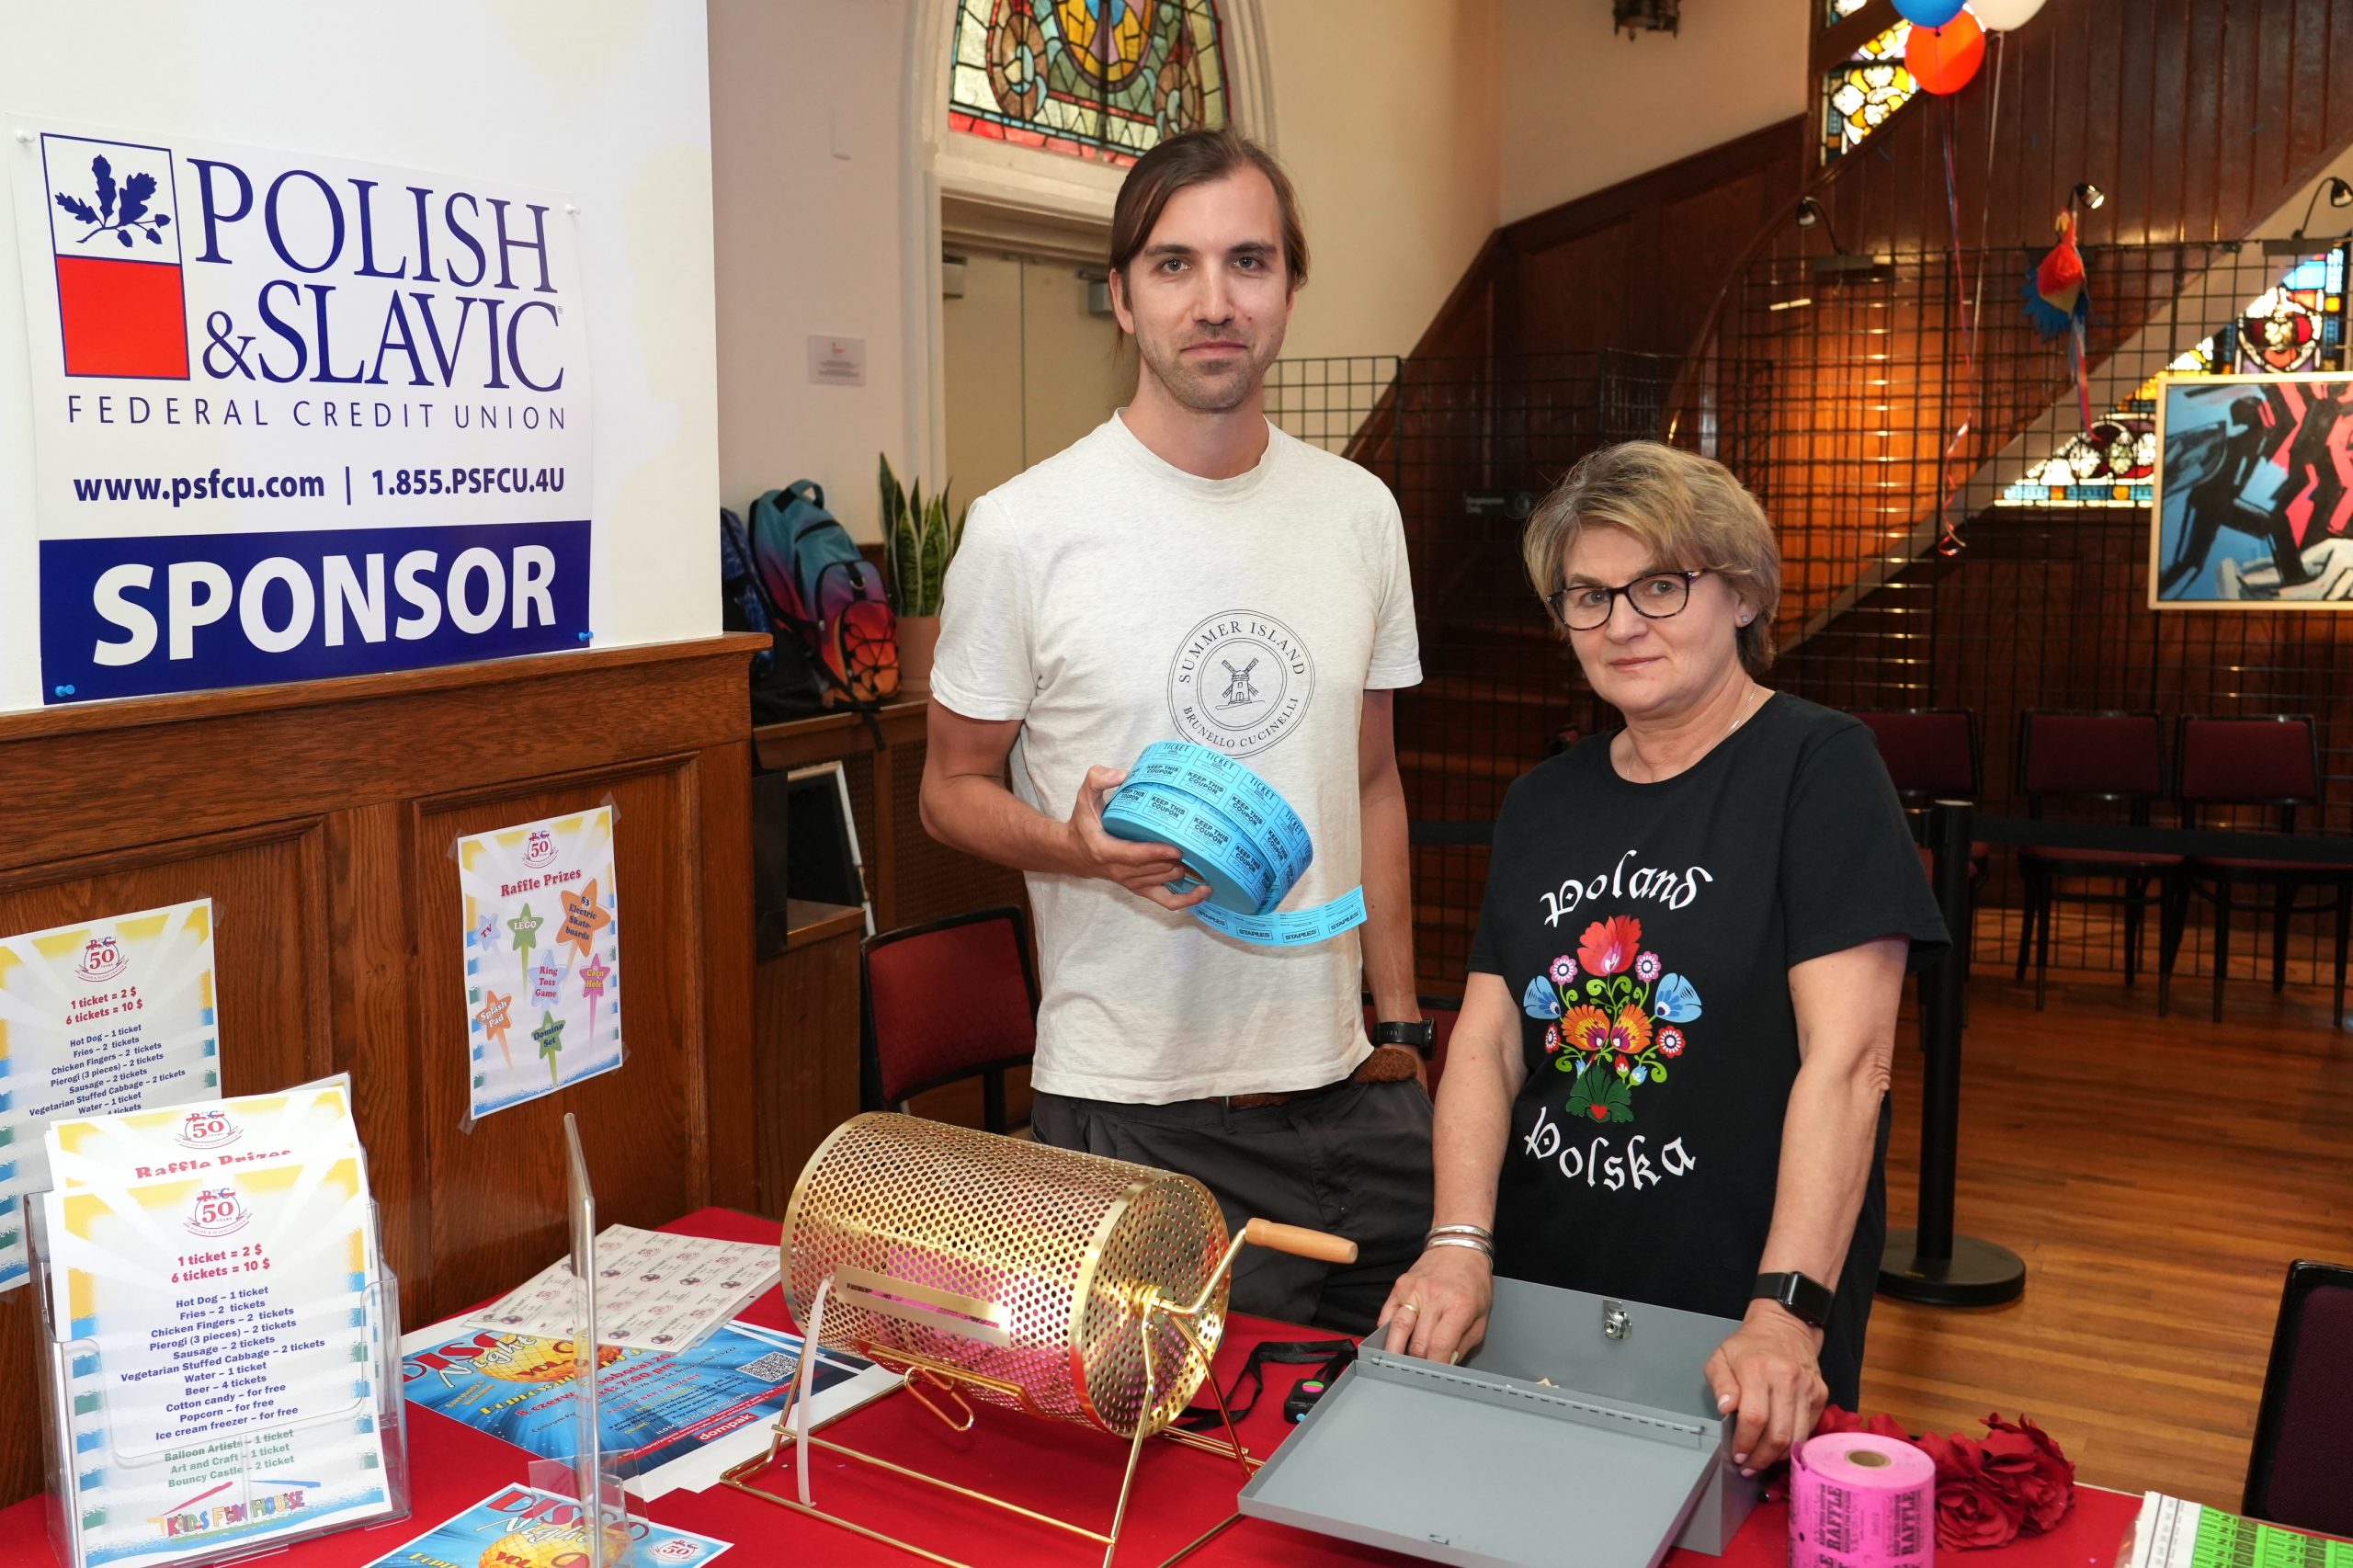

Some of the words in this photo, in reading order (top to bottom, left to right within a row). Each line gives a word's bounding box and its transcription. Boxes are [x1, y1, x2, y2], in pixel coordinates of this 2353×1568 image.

[187, 157, 558, 294] POLISH
[68, 394, 267, 426] FEDERAL
[293, 401, 432, 428] CREDIT
[455, 404, 565, 429] UNION
[74, 469, 324, 507] www.psfcu.com
[372, 467, 565, 497] 1.855.PSFCU.4U
[93, 545, 556, 666] SPONSOR
[1178, 620, 1242, 684] SUMMER
[1250, 621, 1305, 676] ISLAND
[1183, 706, 1235, 748] BRUNELLO
[1240, 698, 1299, 747] CUCINELLI
[1207, 753, 1234, 769] TICKET
[1250, 778, 1276, 800] TICKET
[1152, 796, 1169, 805] KEEP
[1170, 804, 1185, 814] THIS
[1152, 802, 1178, 818] COUPON
[1232, 796, 1249, 812] KEEP
[1251, 810, 1264, 824] THIS
[1233, 803, 1257, 826] COUPON
[1194, 817, 1212, 830] KEEP
[1215, 828, 1229, 842] THIS
[1195, 824, 1223, 845] COUPON
[1285, 811, 1303, 835] TICKET
[531, 841, 548, 858] 50
[501, 877, 540, 897] Raffle
[544, 869, 582, 886] Prizes
[1540, 849, 1713, 927] Poland
[569, 915, 591, 928] Skate-
[570, 903, 597, 919] Electric
[1198, 909, 1225, 927] STAPLES
[1331, 911, 1359, 930] STAPLES
[481, 924, 492, 938] TV
[515, 920, 537, 929] LEGO
[566, 926, 589, 940] boards
[1239, 928, 1270, 937] STAPLES
[1285, 929, 1316, 939] STAPLES
[90, 949, 114, 969] 50
[540, 967, 558, 976] Ring
[540, 978, 555, 986] Toss
[71, 1001, 75, 1009] 1
[79, 994, 108, 1007] ticket
[121, 990, 127, 998] 2
[131, 986, 137, 998] $
[535, 989, 556, 997] Game
[66, 1016, 72, 1025] 6
[75, 1007, 109, 1023] tickets
[122, 1002, 133, 1011] 10
[137, 999, 142, 1009] $
[481, 1002, 507, 1020] Splash
[489, 1016, 505, 1028] Pad
[70, 1039, 85, 1047] Hot
[86, 1034, 102, 1043] Dog
[118, 1024, 142, 1035] ticket
[533, 1023, 563, 1041] Domino
[544, 1038, 556, 1048] Set
[51, 1074, 80, 1086] Pierogi
[82, 1070, 90, 1080] (3
[92, 1063, 120, 1078] pieces)
[136, 1052, 164, 1064] tickets
[29, 1099, 74, 1116] Vegetarian
[76, 1090, 107, 1103] Stuffed
[108, 1080, 143, 1095] Cabbage
[160, 1069, 186, 1081] tickets
[193, 1121, 224, 1138] 50
[1524, 1106, 1696, 1191] Polska
[202, 1201, 233, 1222] 50
[178, 1256, 184, 1267] 1
[188, 1251, 226, 1265] ticket
[243, 1246, 250, 1256] 2
[255, 1244, 262, 1256] $
[172, 1273, 178, 1283] 6
[183, 1267, 227, 1281] tickets
[244, 1261, 257, 1271] 10
[263, 1257, 270, 1269] $
[176, 1299, 194, 1308] Hot
[198, 1295, 218, 1306] Dog
[230, 1291, 235, 1300] 1
[239, 1287, 268, 1298] ticket
[180, 1310, 206, 1320] Fries
[218, 1306, 224, 1314] 2
[230, 1301, 265, 1312] tickets
[152, 1324, 193, 1338] Chicken
[197, 1317, 235, 1330] Fingers
[259, 1308, 294, 1320] tickets
[150, 1336, 188, 1351] Pierogi
[190, 1335, 199, 1346] (3
[203, 1328, 240, 1343] pieces)
[253, 1325, 258, 1334] 2
[261, 1320, 296, 1332] tickets
[173, 1346, 218, 1359] Sausage
[231, 1342, 236, 1350] 2
[240, 1335, 275, 1348] tickets
[121, 1365, 179, 1382] Vegetarian
[183, 1358, 222, 1371] Stuffed
[225, 1349, 269, 1363] Cabbage
[290, 1339, 325, 1351] tickets
[438, 1334, 536, 1388] Night
[185, 1371, 215, 1383] Water
[228, 1368, 233, 1376] 1
[237, 1362, 267, 1374] ticket
[617, 1373, 651, 1386] 7:00
[653, 1362, 676, 1374] pm
[186, 1386, 210, 1396] Beer
[231, 1375, 267, 1388] tickets
[166, 1400, 201, 1412] Cotton
[205, 1394, 235, 1406] candy
[247, 1389, 262, 1397] for
[265, 1384, 286, 1393] free
[180, 1409, 222, 1423] Popcorn
[235, 1403, 250, 1412] for
[253, 1399, 274, 1409] free
[155, 1430, 172, 1440] Ice
[175, 1425, 208, 1437] cream
[210, 1417, 248, 1430] freezer
[259, 1412, 275, 1421] for
[277, 1407, 298, 1416] free
[699, 1414, 753, 1441] dompak
[165, 1449, 205, 1461] Balloon
[208, 1440, 243, 1453] Artists
[263, 1429, 293, 1442] ticket
[171, 1465, 186, 1474] Art
[189, 1460, 209, 1471] and
[212, 1454, 239, 1466] Craft
[251, 1449, 256, 1458] 1
[259, 1444, 290, 1456] ticket
[168, 1473, 207, 1487] Bouncy
[210, 1466, 244, 1479] Castle
[265, 1455, 294, 1468] ticket
[212, 1503, 247, 1527] FUN
[252, 1491, 304, 1517] HOUSE
[1827, 1485, 1842, 1552] RAFFLE
[1902, 1492, 1915, 1555] RAFFLE
